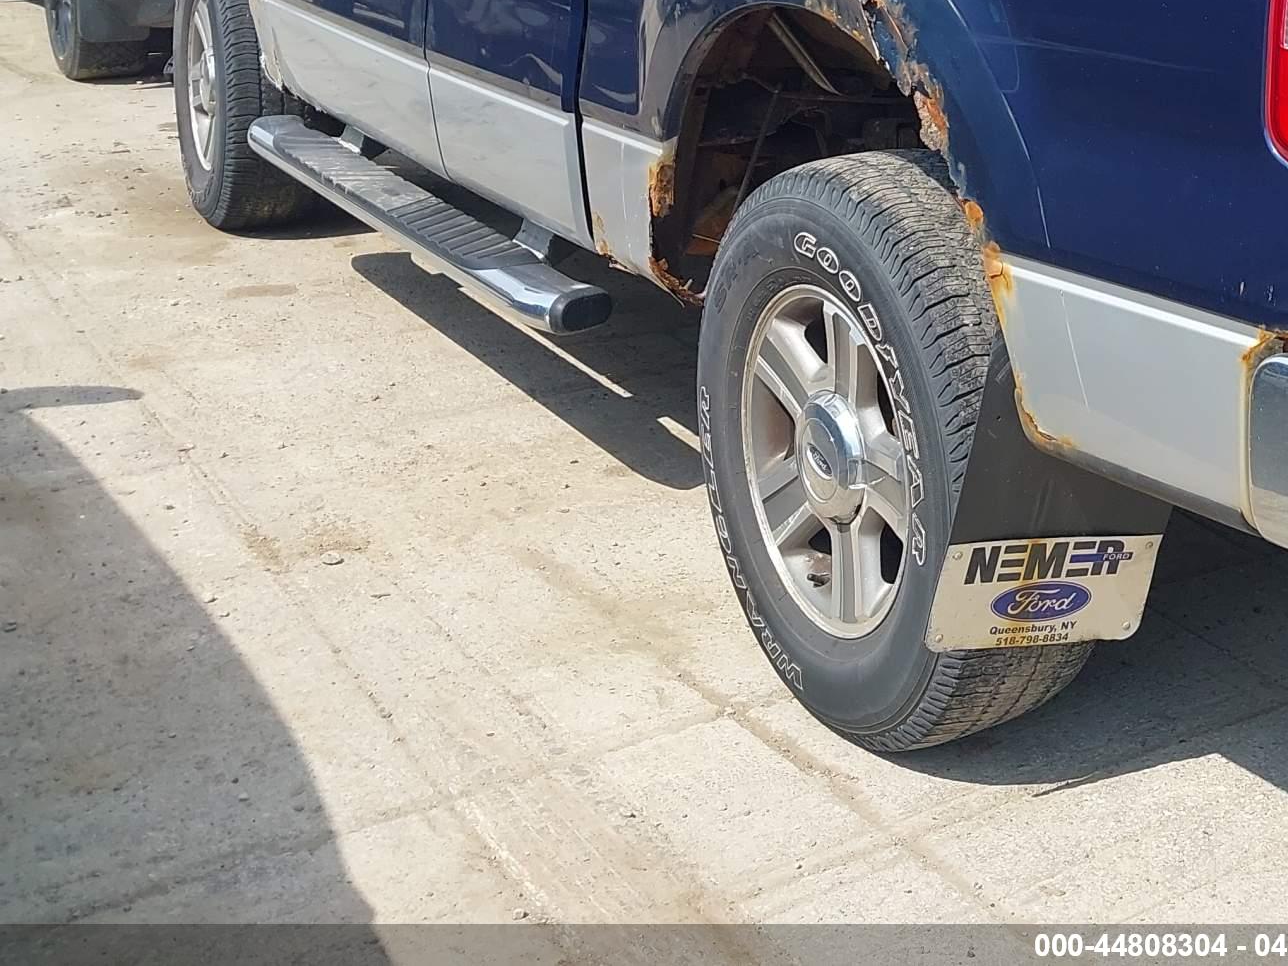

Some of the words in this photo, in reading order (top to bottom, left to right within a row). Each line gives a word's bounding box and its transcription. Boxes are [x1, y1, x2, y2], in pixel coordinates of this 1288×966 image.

[793, 232, 926, 566] GOODYEAR
[699, 386, 803, 690] WRANGLER
[964, 540, 1125, 585] NEMER
[1102, 552, 1131, 561] FORD
[1007, 589, 1077, 615] Ford
[989, 624, 1057, 636] Queensbury,
[1060, 620, 1078, 630] NY
[995, 633, 1069, 646] 518-798-8834
